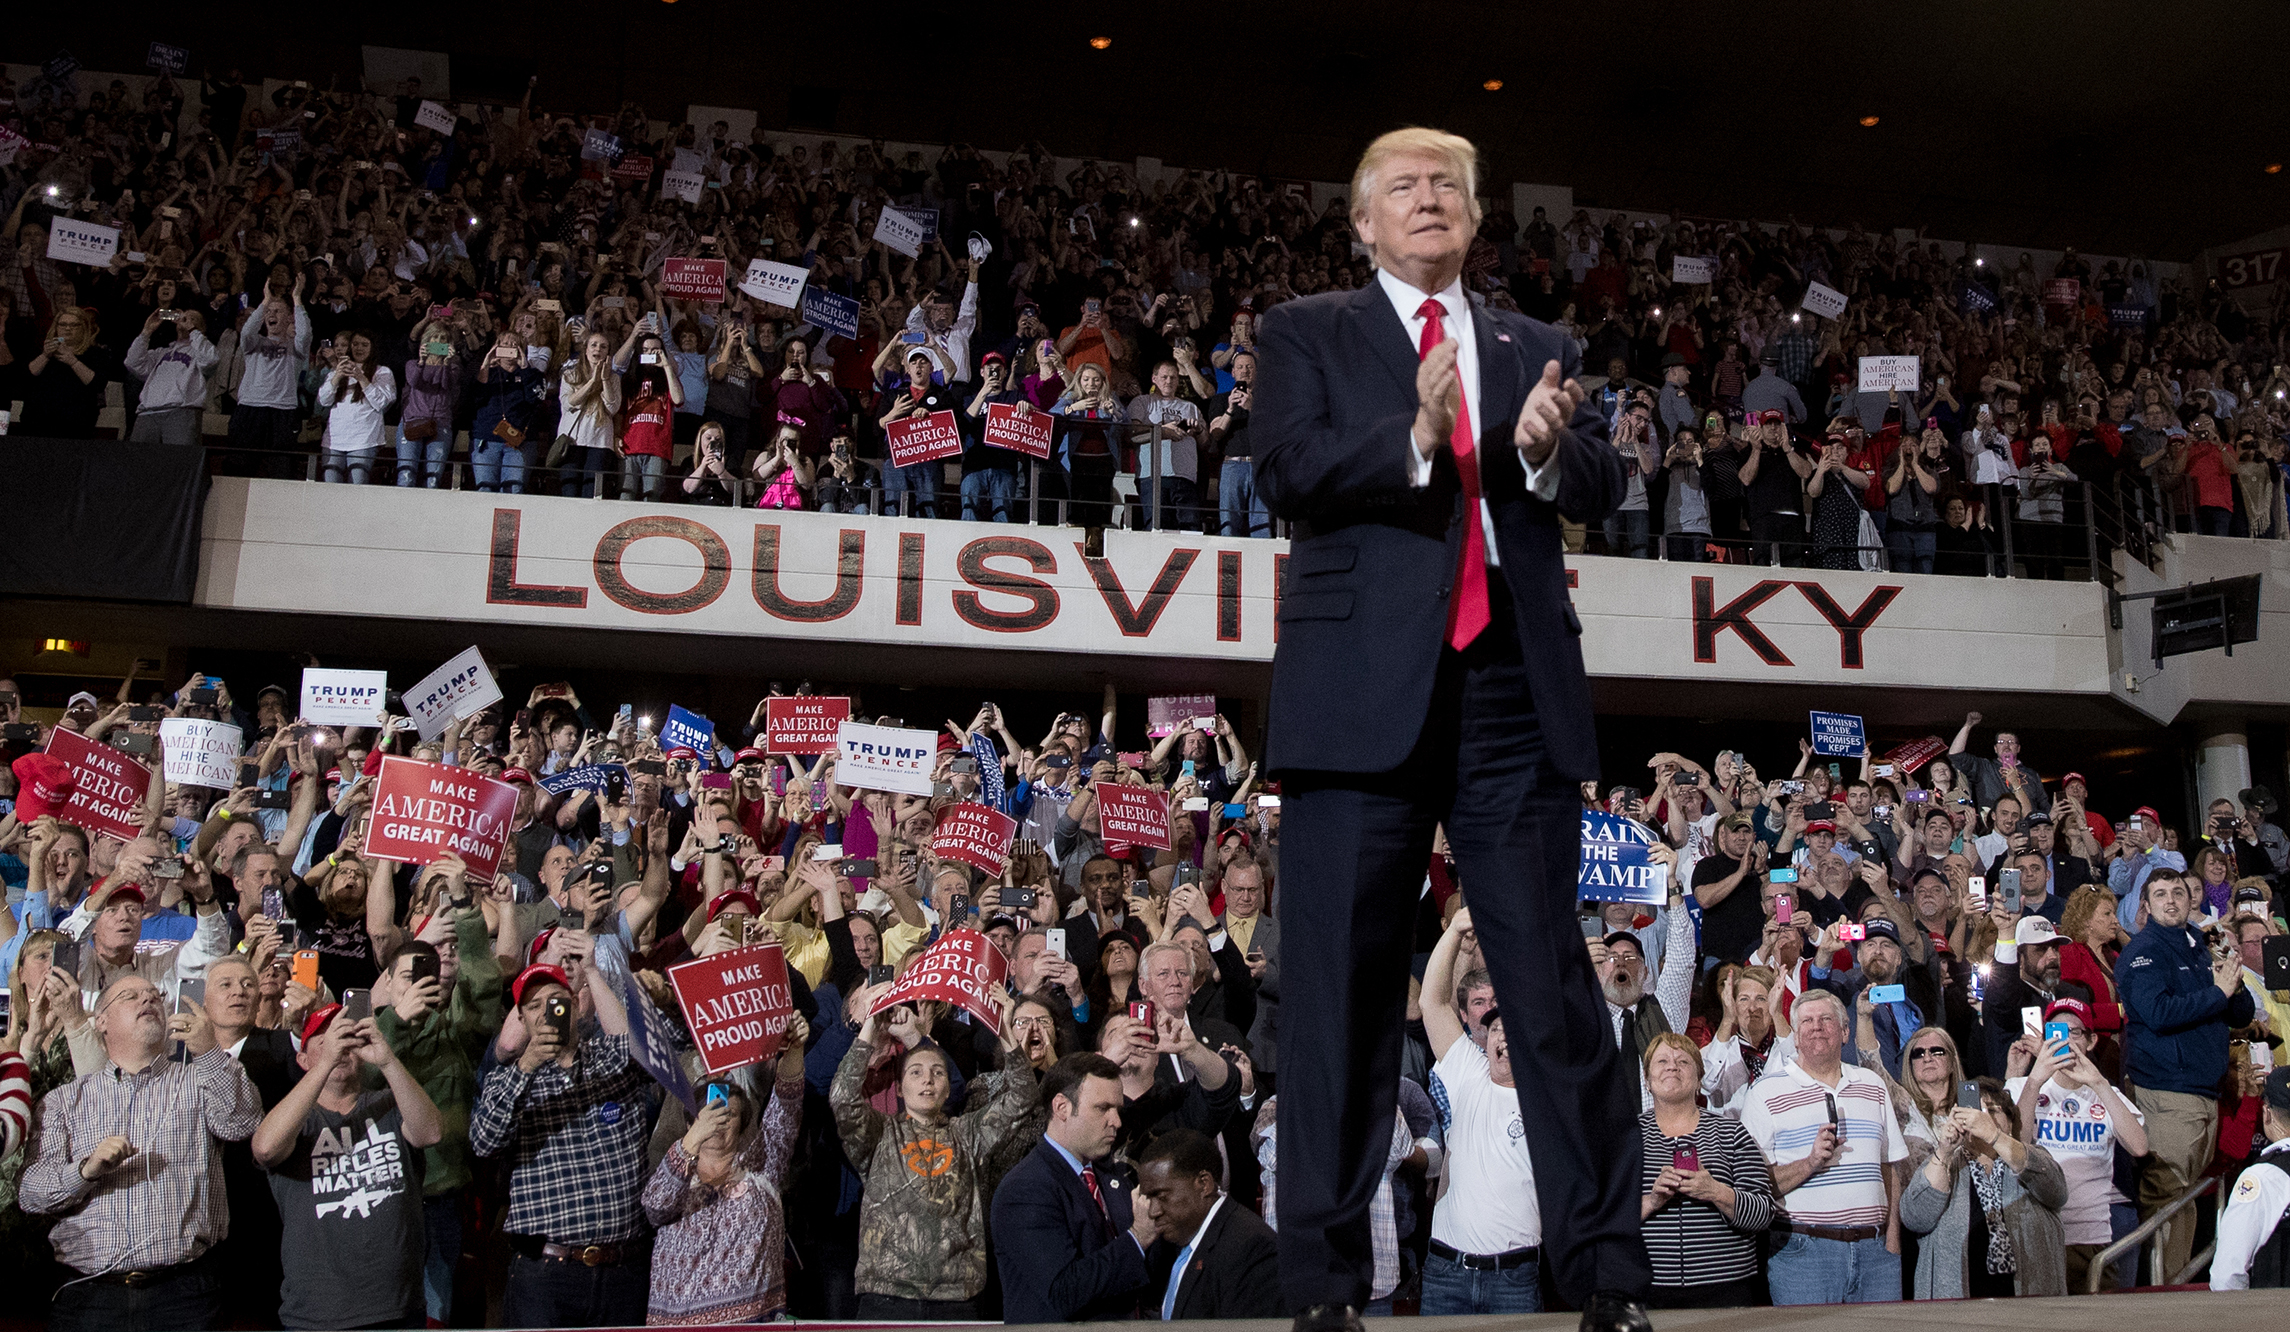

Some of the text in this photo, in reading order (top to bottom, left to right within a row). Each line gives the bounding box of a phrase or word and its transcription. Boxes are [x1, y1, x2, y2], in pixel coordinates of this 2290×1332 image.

[155, 45, 183, 58] DRAIN
[150, 56, 182, 69] SWAMP
[423, 106, 454, 123] TRUMP
[0, 125, 31, 148] OMEN
[590, 136, 624, 154] TRUMP
[617, 162, 652, 172] MERICA
[666, 177, 699, 187] TRUMP
[899, 209, 935, 220] ROMISES
[884, 217, 920, 239] TRUMP
[57, 228, 112, 246] TRUMP
[60, 237, 107, 251] PENCE
[682, 264, 706, 273] MAKE
[2225, 252, 2284, 287] 317
[664, 272, 724, 287] AMERICA
[751, 269, 799, 286] TRUMP
[752, 277, 793, 291] PENCE
[666, 283, 722, 295] PROUD AGAIN
[1966, 288, 1994, 307] TRUMP
[823, 295, 842, 308] MAKE
[1811, 289, 1842, 307] TRUMP
[805, 297, 856, 325] AMERICA
[2111, 308, 2145, 316] TRUMP
[805, 309, 855, 333] STRONG AGAIN
[1863, 364, 1915, 374] AMERICAN
[727, 375, 747, 388] HOME
[1863, 379, 1915, 388] AMERICAN
[629, 413, 664, 425] CARDINALS
[909, 419, 933, 431] MAKE
[1011, 411, 1033, 423] MAKE
[892, 425, 957, 449] AMERICA
[988, 416, 1050, 441] AMERICA
[989, 428, 1047, 450] PROUD AGAIN
[895, 438, 957, 459] PROUD AGAIN
[487, 507, 1904, 669] LOUISVI KY
[309, 685, 378, 697] TRUMP
[416, 664, 478, 713] TRUMP
[315, 697, 371, 705] PENCE
[426, 679, 477, 718] PENCE
[1151, 694, 1215, 704] WOMEN
[796, 706, 823, 714] MAKE
[1170, 708, 1194, 717] FOR
[186, 725, 213, 737] BUY
[1816, 716, 1859, 729] PROMISES
[1826, 725, 1852, 735] MADE
[671, 720, 709, 743] TRUMP
[775, 733, 807, 743] GREAT
[1817, 734, 1861, 746] PROMISES
[670, 731, 705, 751] PENCE
[1828, 743, 1850, 753] KEPT
[180, 750, 210, 763] HIRE
[847, 741, 928, 759] TRUMP
[1902, 741, 1940, 768] PROUD AGAIN
[85, 752, 122, 776] MAKE
[853, 754, 919, 769] PENCE
[429, 779, 477, 802] MAKE
[1122, 793, 1147, 804] MAKE
[376, 793, 505, 844] AMERICA
[958, 810, 989, 825] MAKE
[1102, 803, 1168, 826] AMERICA
[1108, 819, 1165, 838] GREAT AGAIN
[1580, 820, 1651, 846] RAIN
[383, 823, 494, 861] GREAT AGAIN
[932, 822, 1008, 853] AMERICA
[932, 838, 1001, 863] GREAT AGAIN
[1582, 844, 1618, 861] THE
[925, 940, 973, 957] MAKE
[721, 964, 763, 986] MAKE
[877, 972, 999, 1015] PROUD AGAIN
[695, 983, 793, 1029] AMERICA
[703, 1020, 763, 1052] PROUD
[310, 1117, 397, 1157] ALL
[2038, 1140, 2066, 1149] AMERICA
[2066, 1144, 2087, 1152] GREAT
[311, 1141, 401, 1177] RIFLES
[312, 1161, 404, 1195] MATTER
